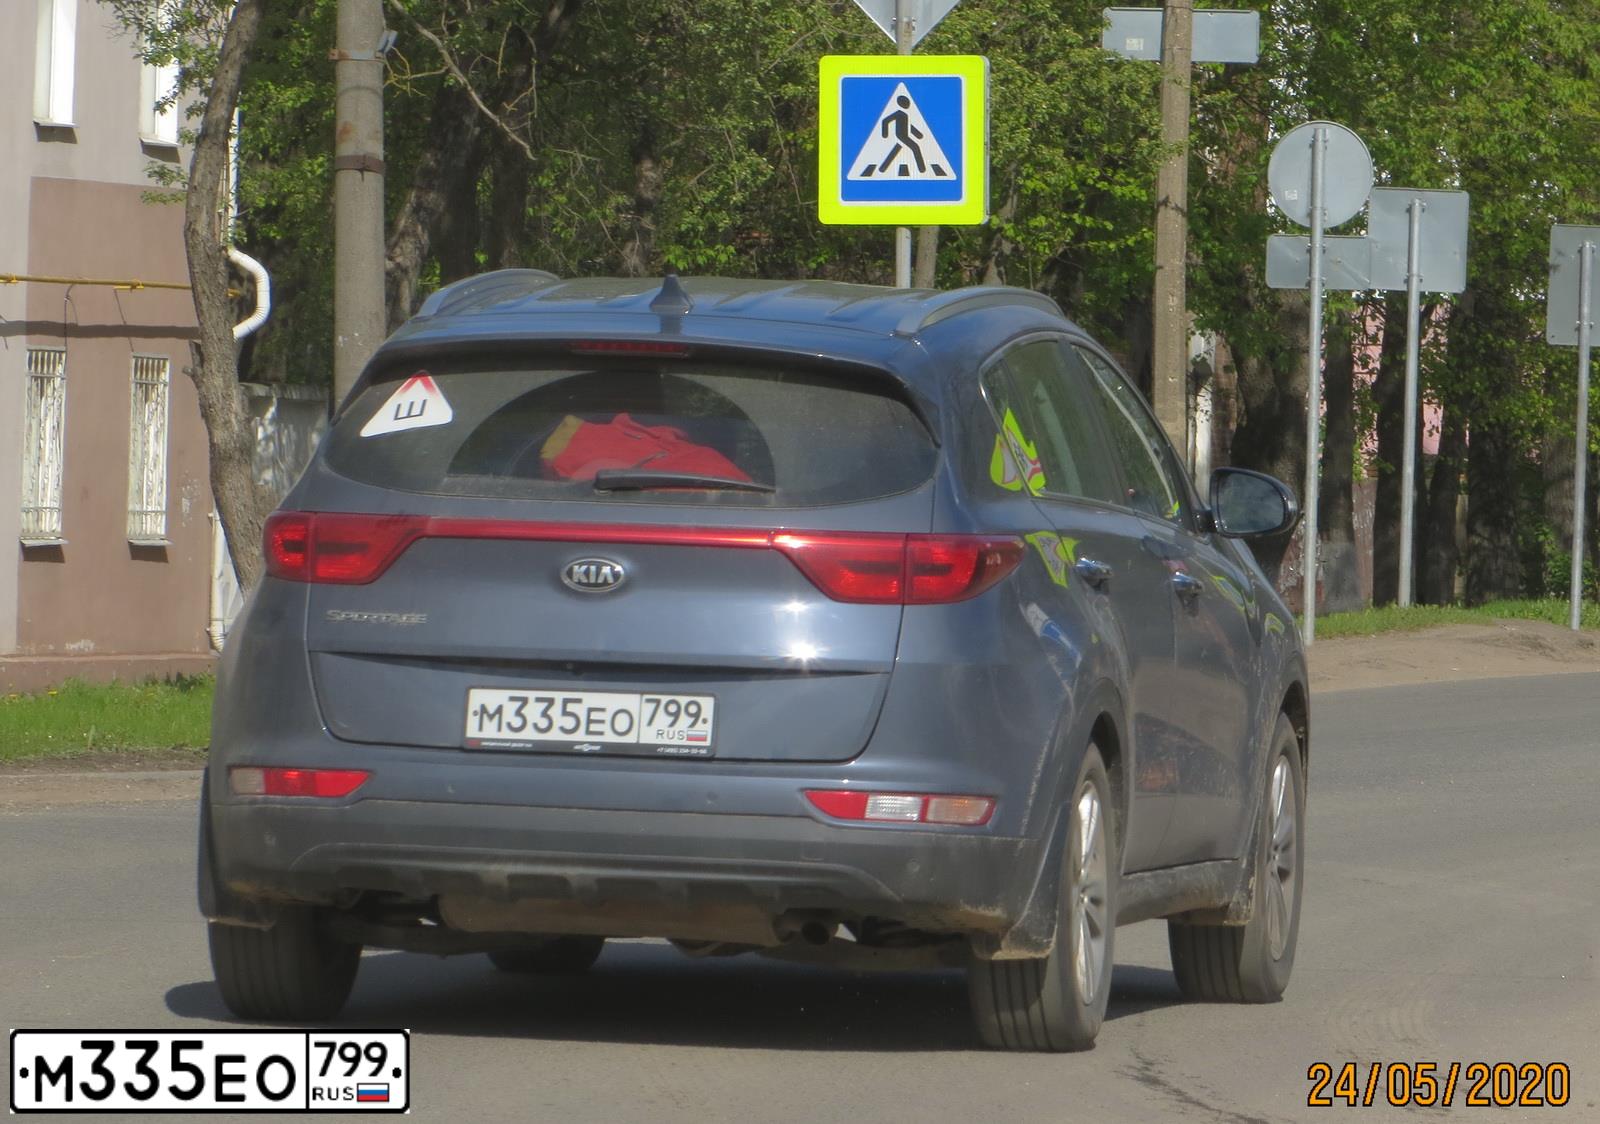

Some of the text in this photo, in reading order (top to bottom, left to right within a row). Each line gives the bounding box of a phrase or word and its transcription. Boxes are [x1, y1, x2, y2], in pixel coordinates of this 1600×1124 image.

[572, 565, 614, 583] KIA
[644, 698, 702, 729] 799
[656, 729, 685, 741] RUS
